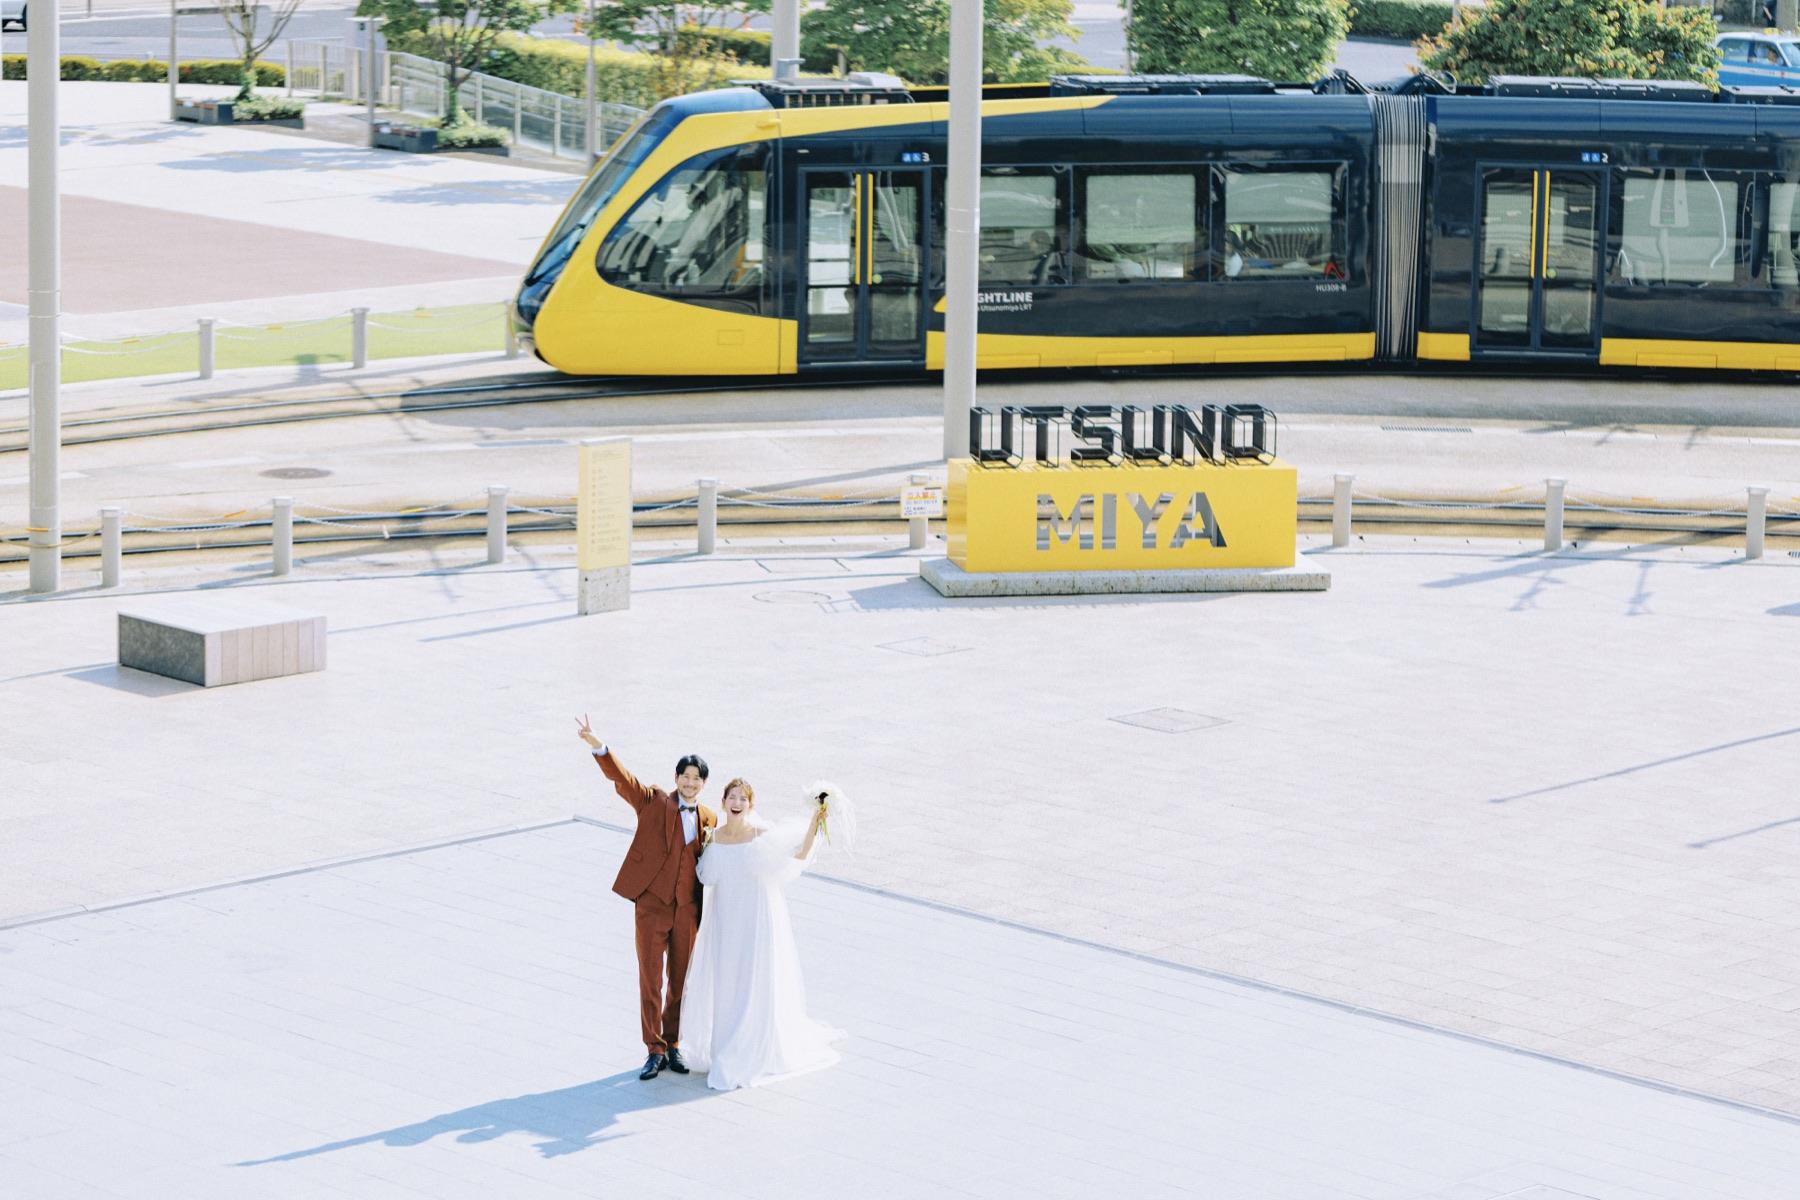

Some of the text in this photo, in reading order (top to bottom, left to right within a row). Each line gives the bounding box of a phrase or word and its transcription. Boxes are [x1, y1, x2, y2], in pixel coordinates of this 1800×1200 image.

[921, 152, 930, 162] 3
[1601, 152, 1609, 163] 2
[970, 403, 1277, 469] UTSUNO
[1036, 492, 1228, 550] MIYA
